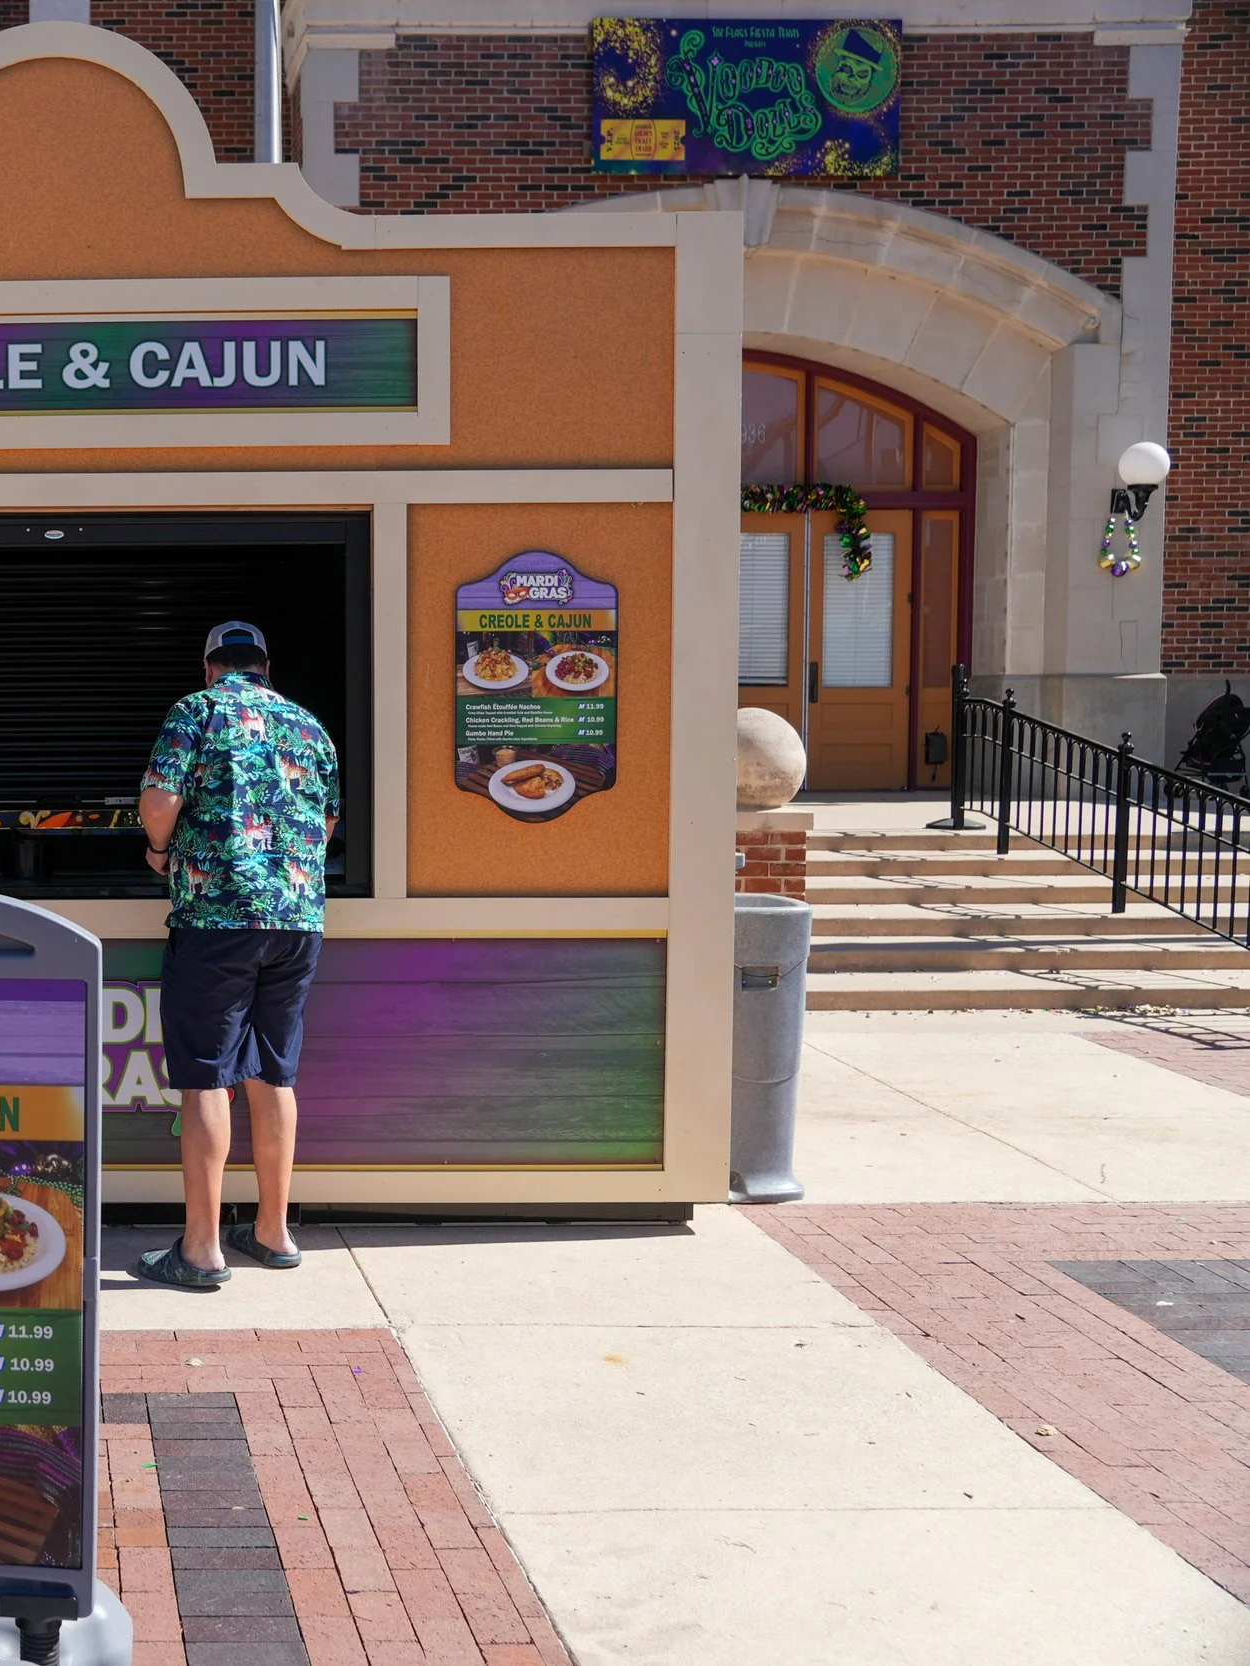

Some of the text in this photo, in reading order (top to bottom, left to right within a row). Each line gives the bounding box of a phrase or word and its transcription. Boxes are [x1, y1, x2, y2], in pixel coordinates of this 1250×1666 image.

[61, 341, 111, 390] &
[130, 339, 327, 389] CAJUN
[516, 574, 559, 587] MARDI
[529, 587, 567, 599] GRAS
[479, 614, 591, 629] CREOLE & CAJUN
[8, 1325, 53, 1339] 11.99
[10, 1357, 54, 1372] 10.99
[8, 1390, 52, 1404] 10.99
